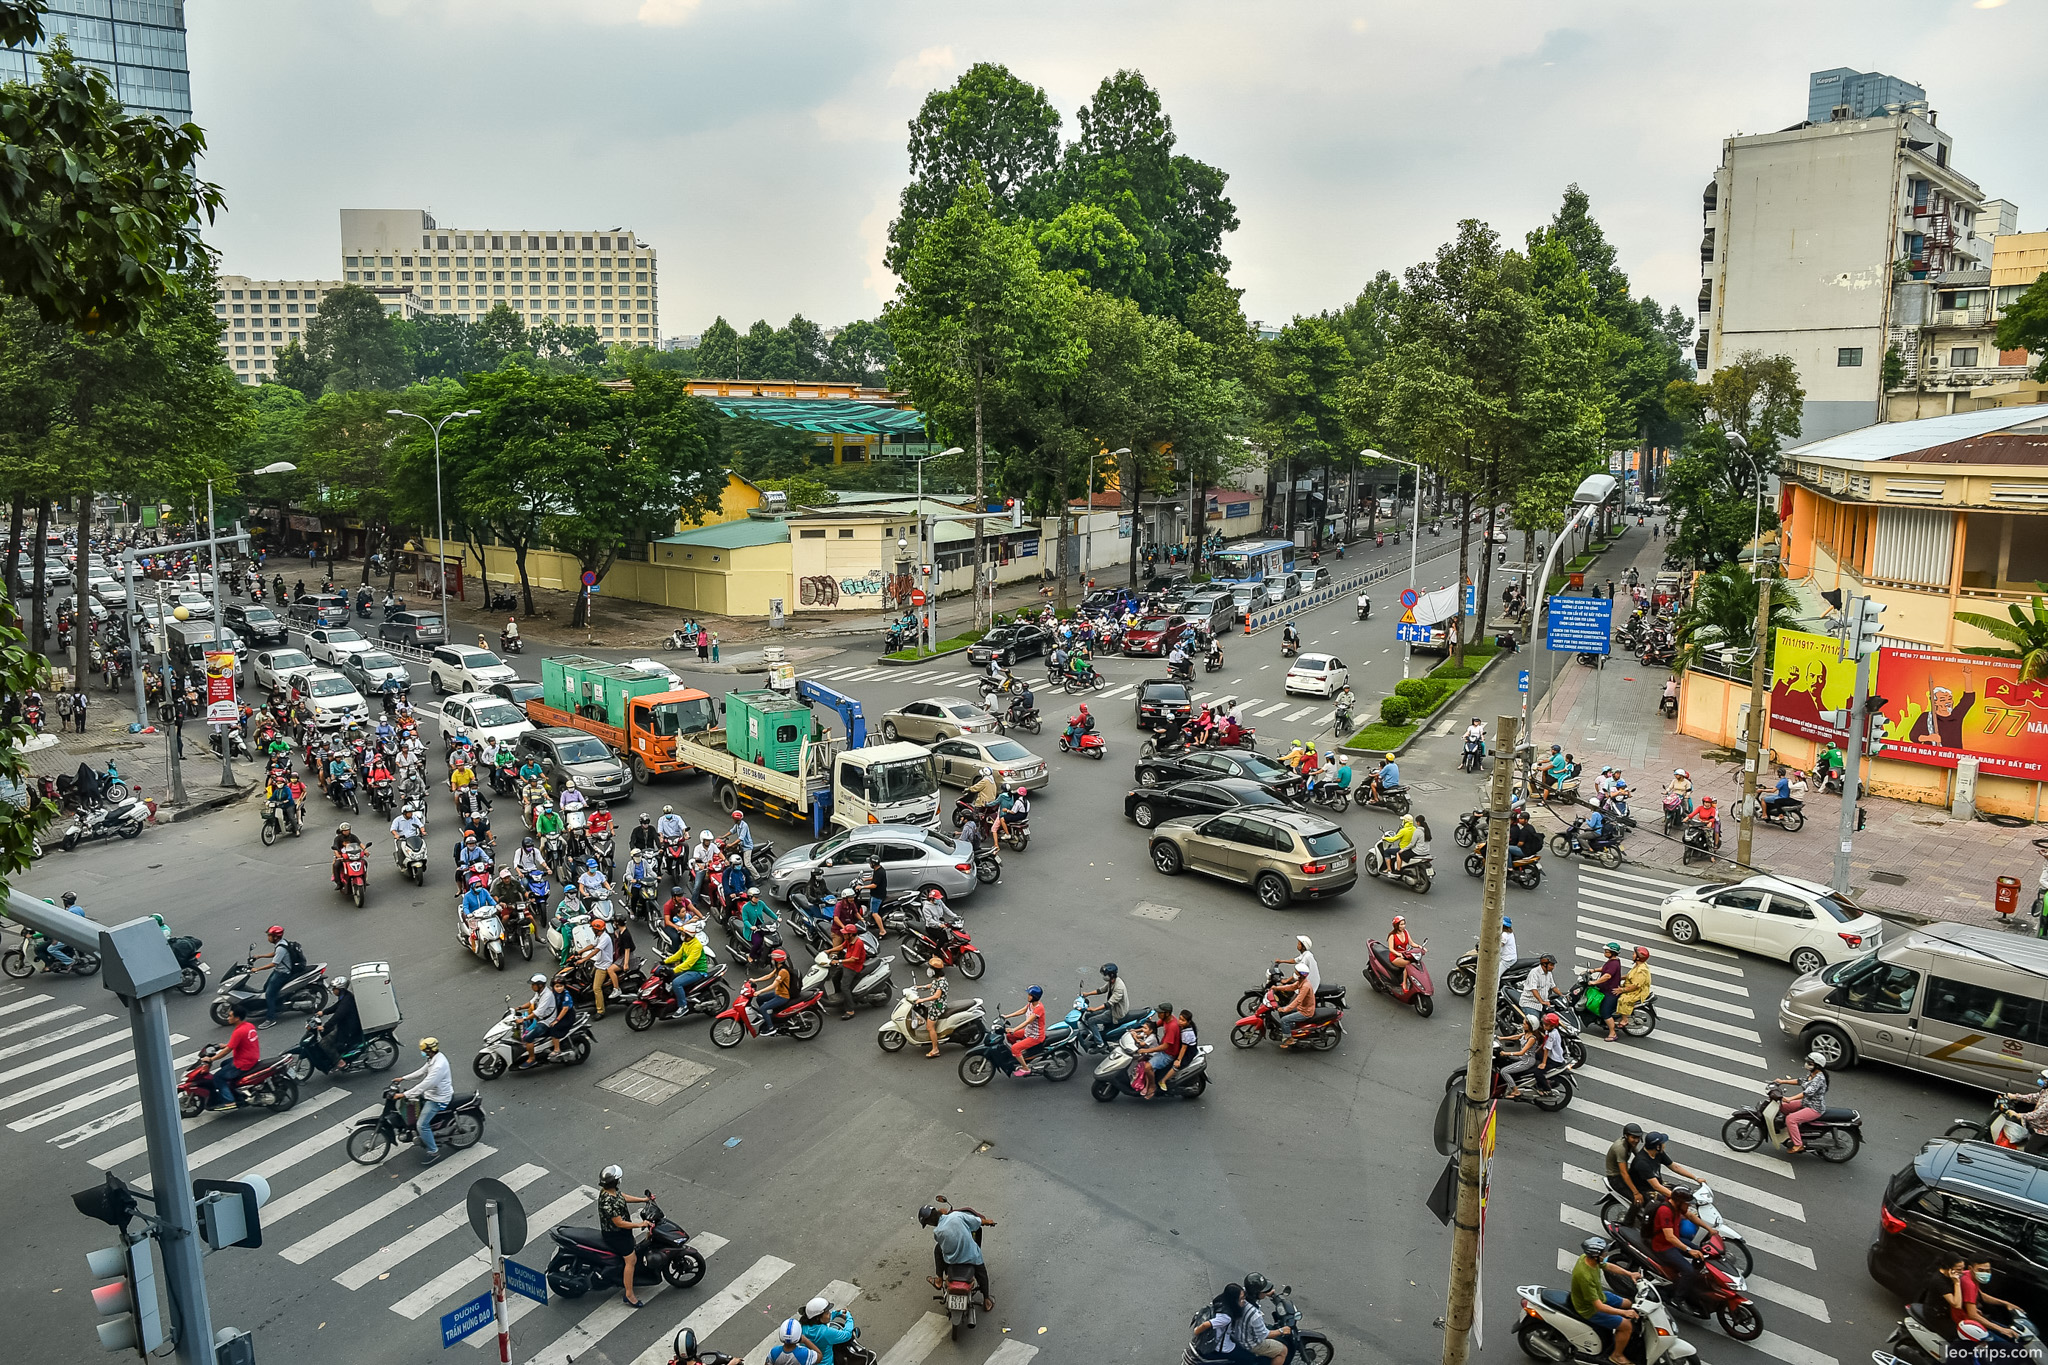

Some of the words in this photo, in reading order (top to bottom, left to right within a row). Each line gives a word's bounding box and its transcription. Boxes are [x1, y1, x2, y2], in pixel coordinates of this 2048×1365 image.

[1816, 75, 1839, 84] Keppel
[1782, 636, 1814, 650] 7/11/1917
[1983, 706, 2031, 737] 77
[1918, 748, 1937, 756] NGÀY
[2008, 760, 2022, 768] BẤT
[2024, 762, 2042, 771] DIỆT
[454, 1302, 480, 1322] ĐƯỜNG
[479, 1309, 490, 1323] ĐẠO
